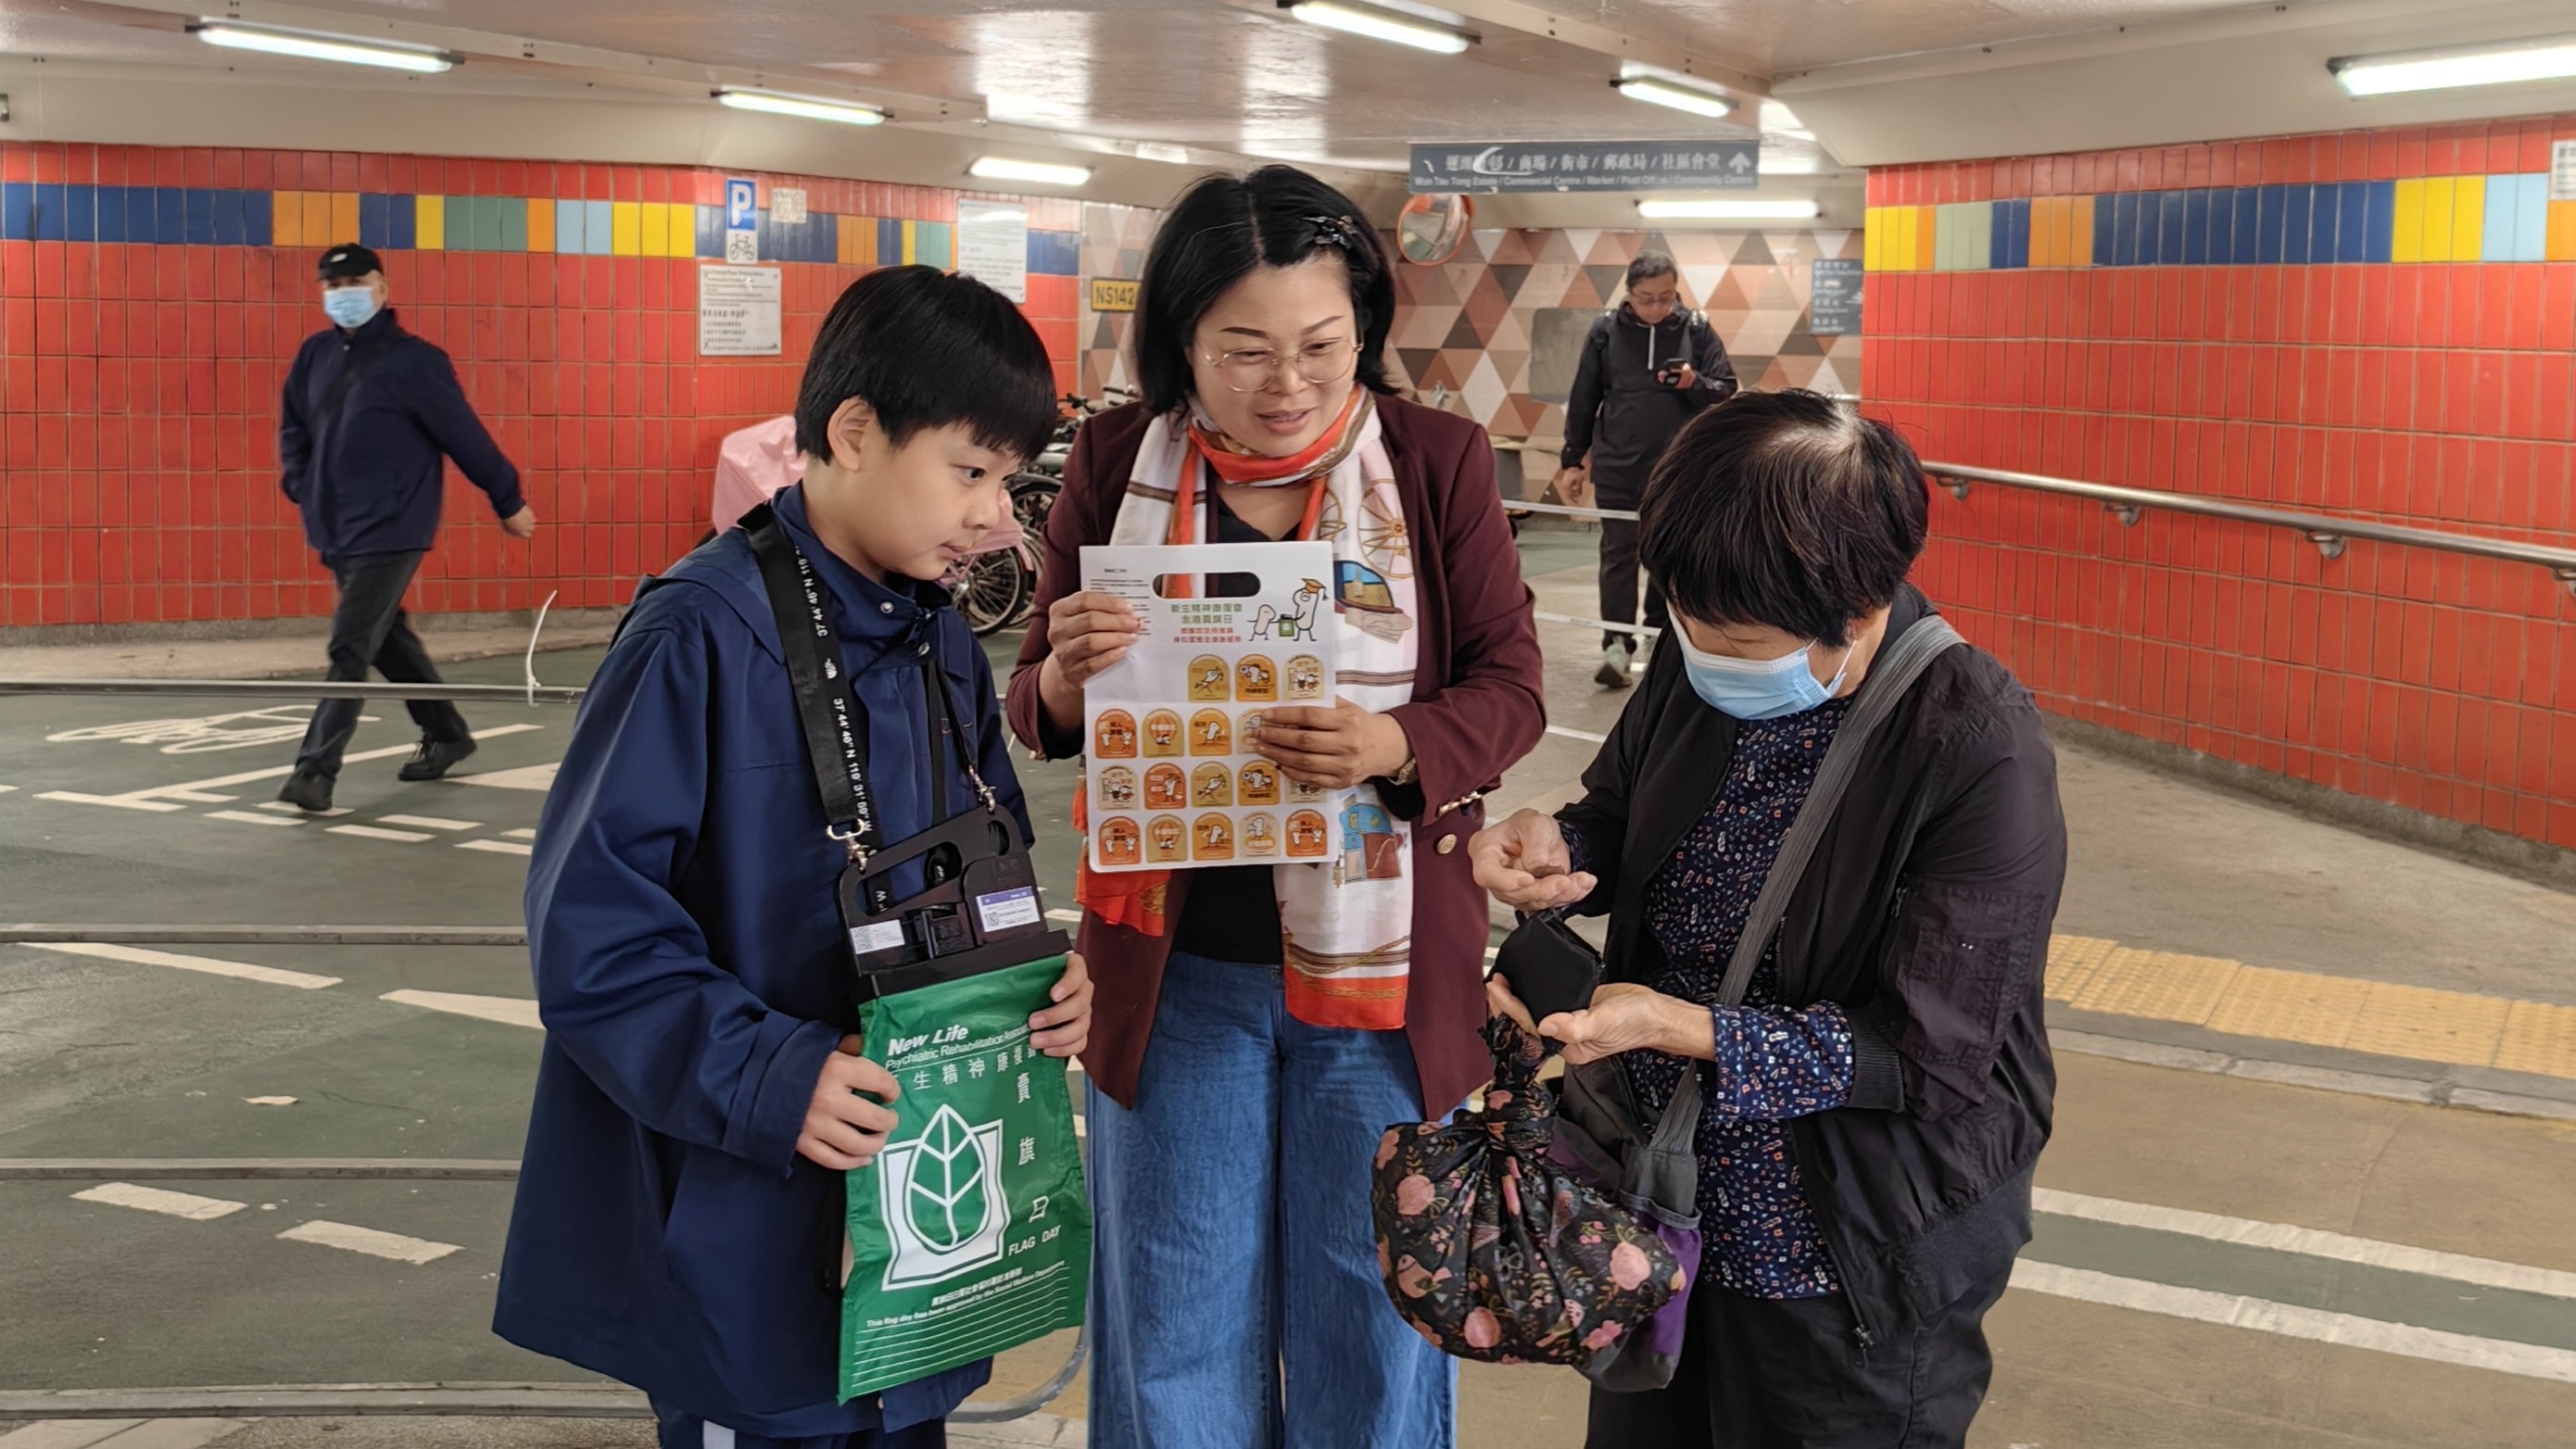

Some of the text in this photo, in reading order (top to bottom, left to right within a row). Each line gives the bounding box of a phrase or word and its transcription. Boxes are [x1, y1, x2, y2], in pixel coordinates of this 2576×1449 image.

[1446, 154, 1504, 171] 運頭邨
[731, 183, 751, 226] P
[1096, 287, 1135, 305] NS142
[845, 749, 857, 759] N
[885, 1048, 939, 1071] Psychiatric
[940, 1033, 1004, 1057] Rehabilitation
[887, 1024, 969, 1056] New Life
[1008, 1225, 1061, 1256] FLAG DAY
[866, 1318, 883, 1328] This
[883, 1315, 899, 1326] flag
[899, 1312, 913, 1323] day
[914, 1309, 928, 1319] has
